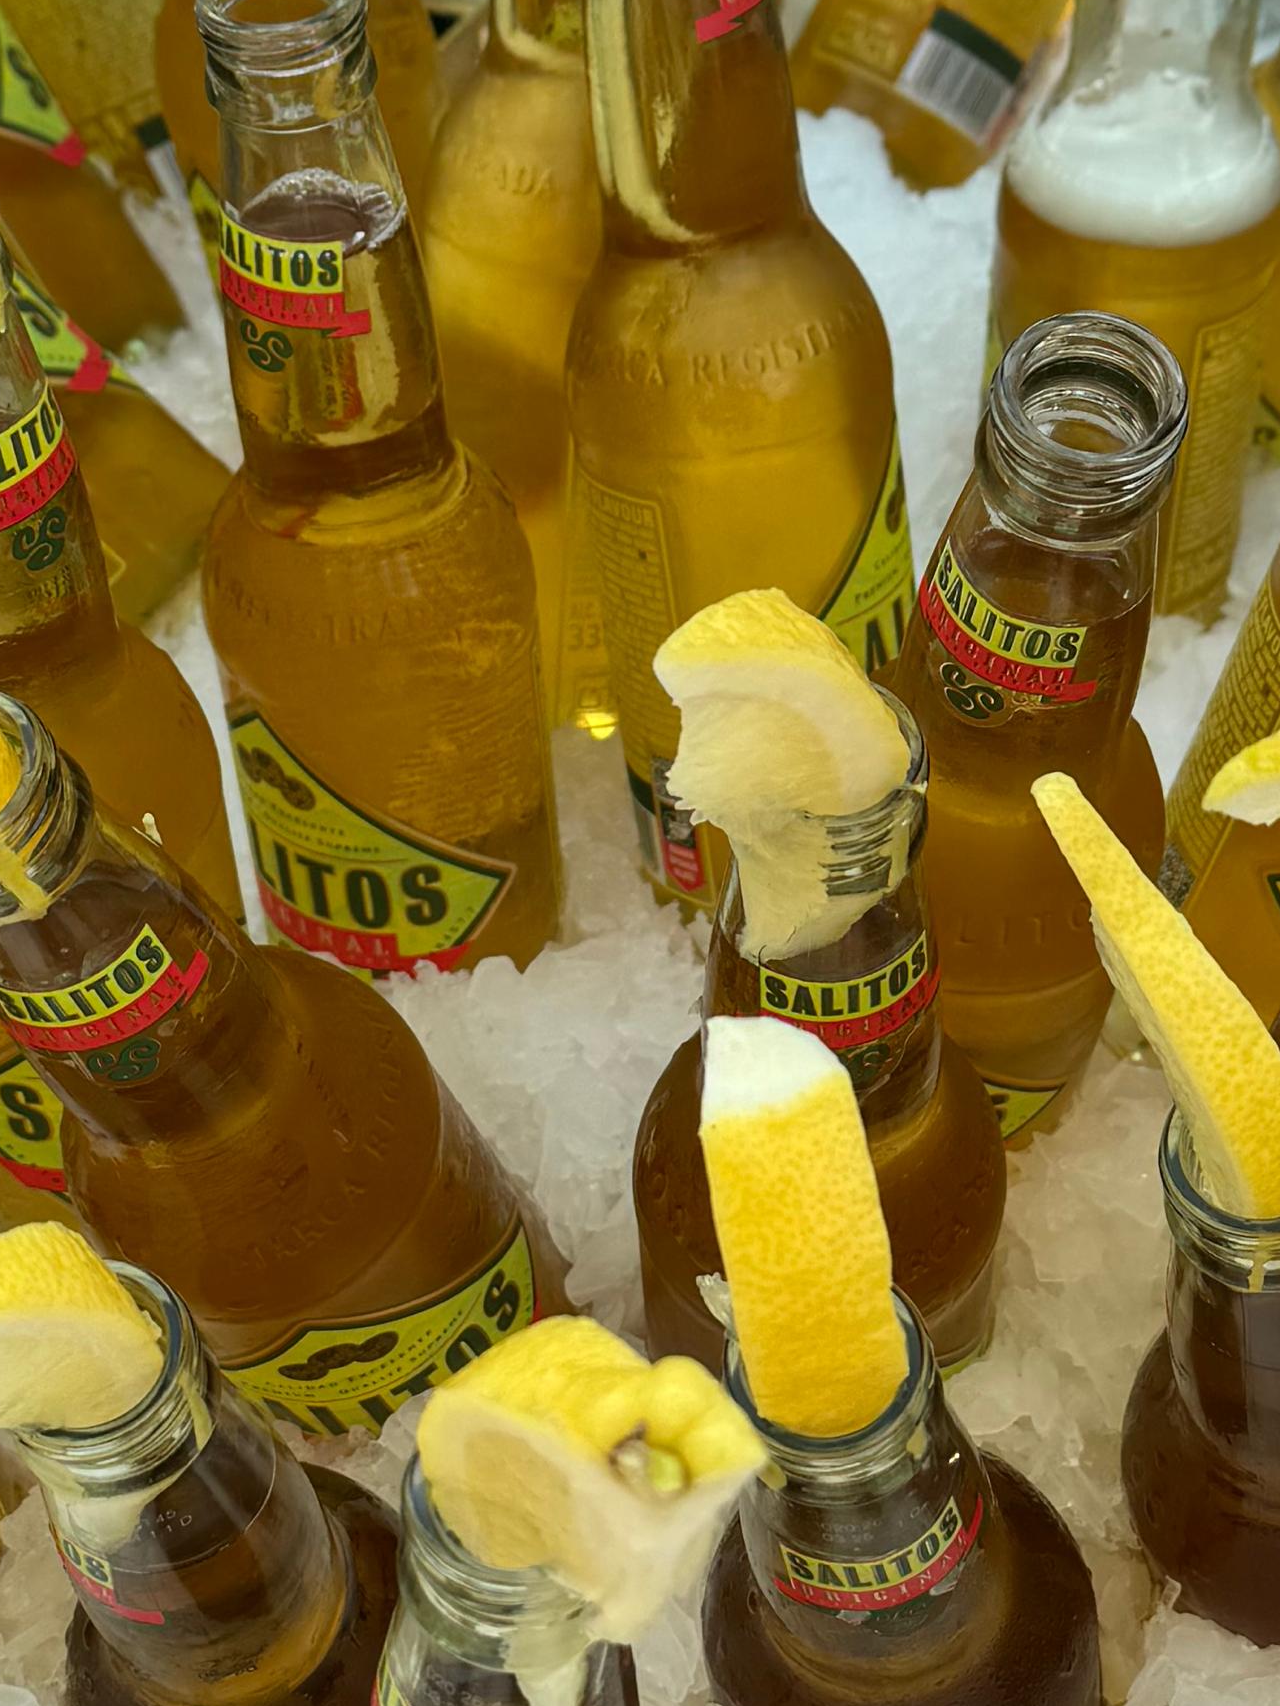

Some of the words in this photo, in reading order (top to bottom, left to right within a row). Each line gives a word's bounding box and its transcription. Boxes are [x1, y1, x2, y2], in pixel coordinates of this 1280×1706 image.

[221, 224, 340, 288] ALITOS
[938, 549, 1081, 663] SALITOS
[765, 940, 926, 1017] SALITOS
[785, 1505, 960, 1589] SALITOS
